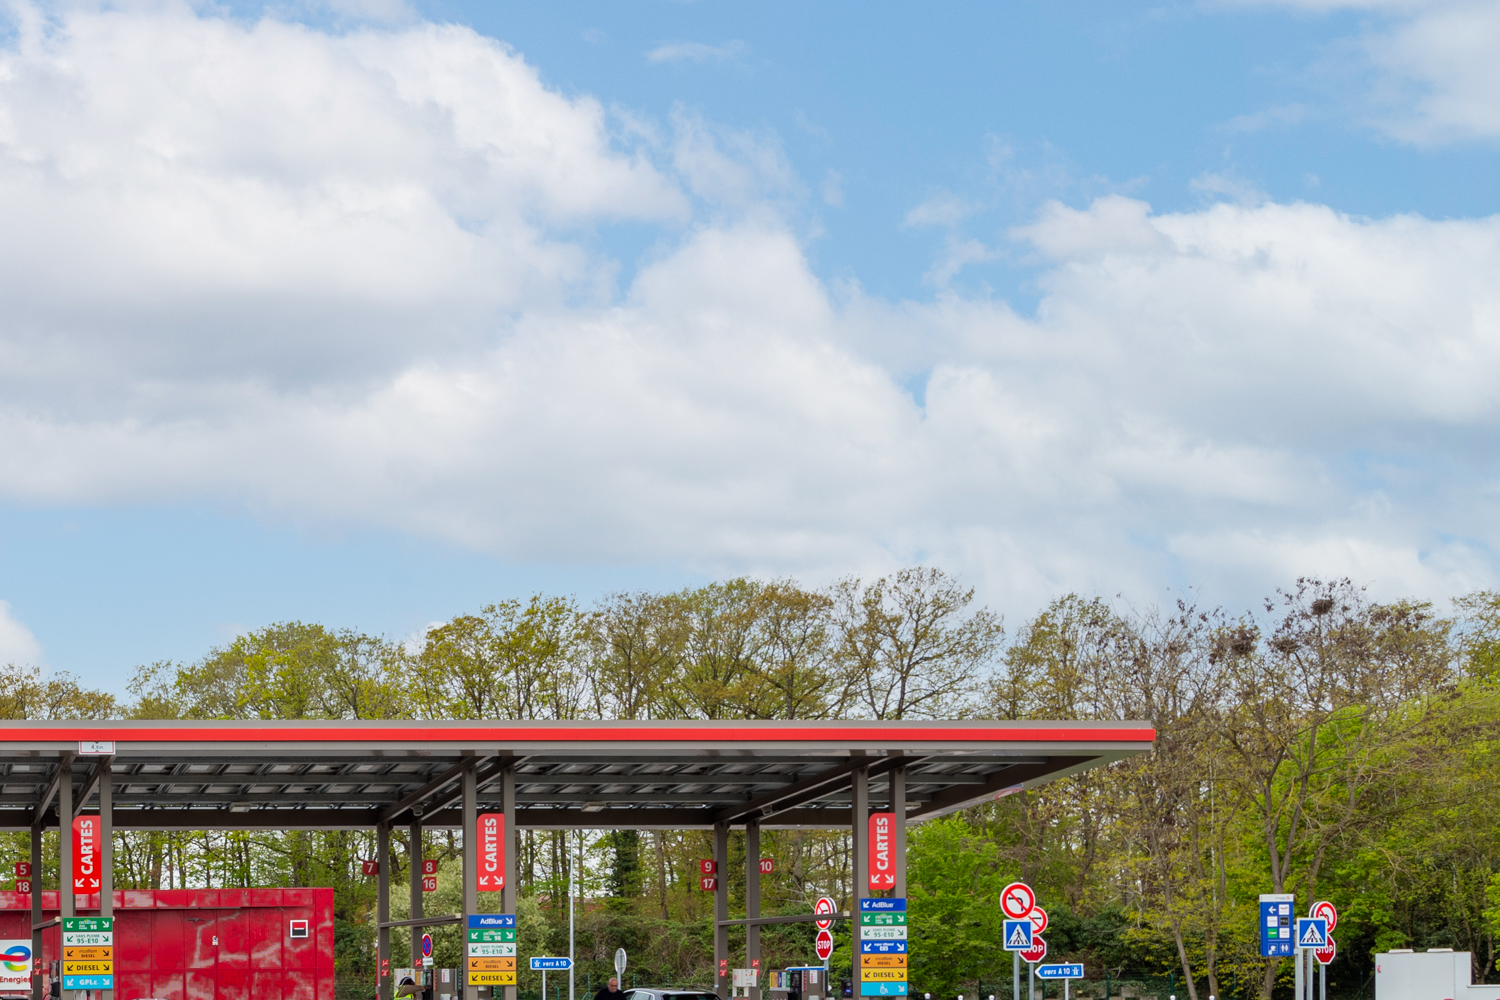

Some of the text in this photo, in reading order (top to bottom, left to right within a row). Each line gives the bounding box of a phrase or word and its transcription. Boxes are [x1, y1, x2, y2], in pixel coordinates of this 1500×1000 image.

[81, 820, 93, 874] CARTES
[485, 818, 497, 872] CARTES
[877, 818, 888, 870] CARTES
[20, 864, 27, 875] 5
[367, 863, 374, 873] 7
[426, 862, 433, 872] 8
[705, 862, 712, 872] 9
[760, 861, 772, 871] 10
[17, 882, 30, 892] 18
[424, 879, 436, 889] 16
[703, 879, 714, 889] 17
[818, 940, 830, 949] STOP
